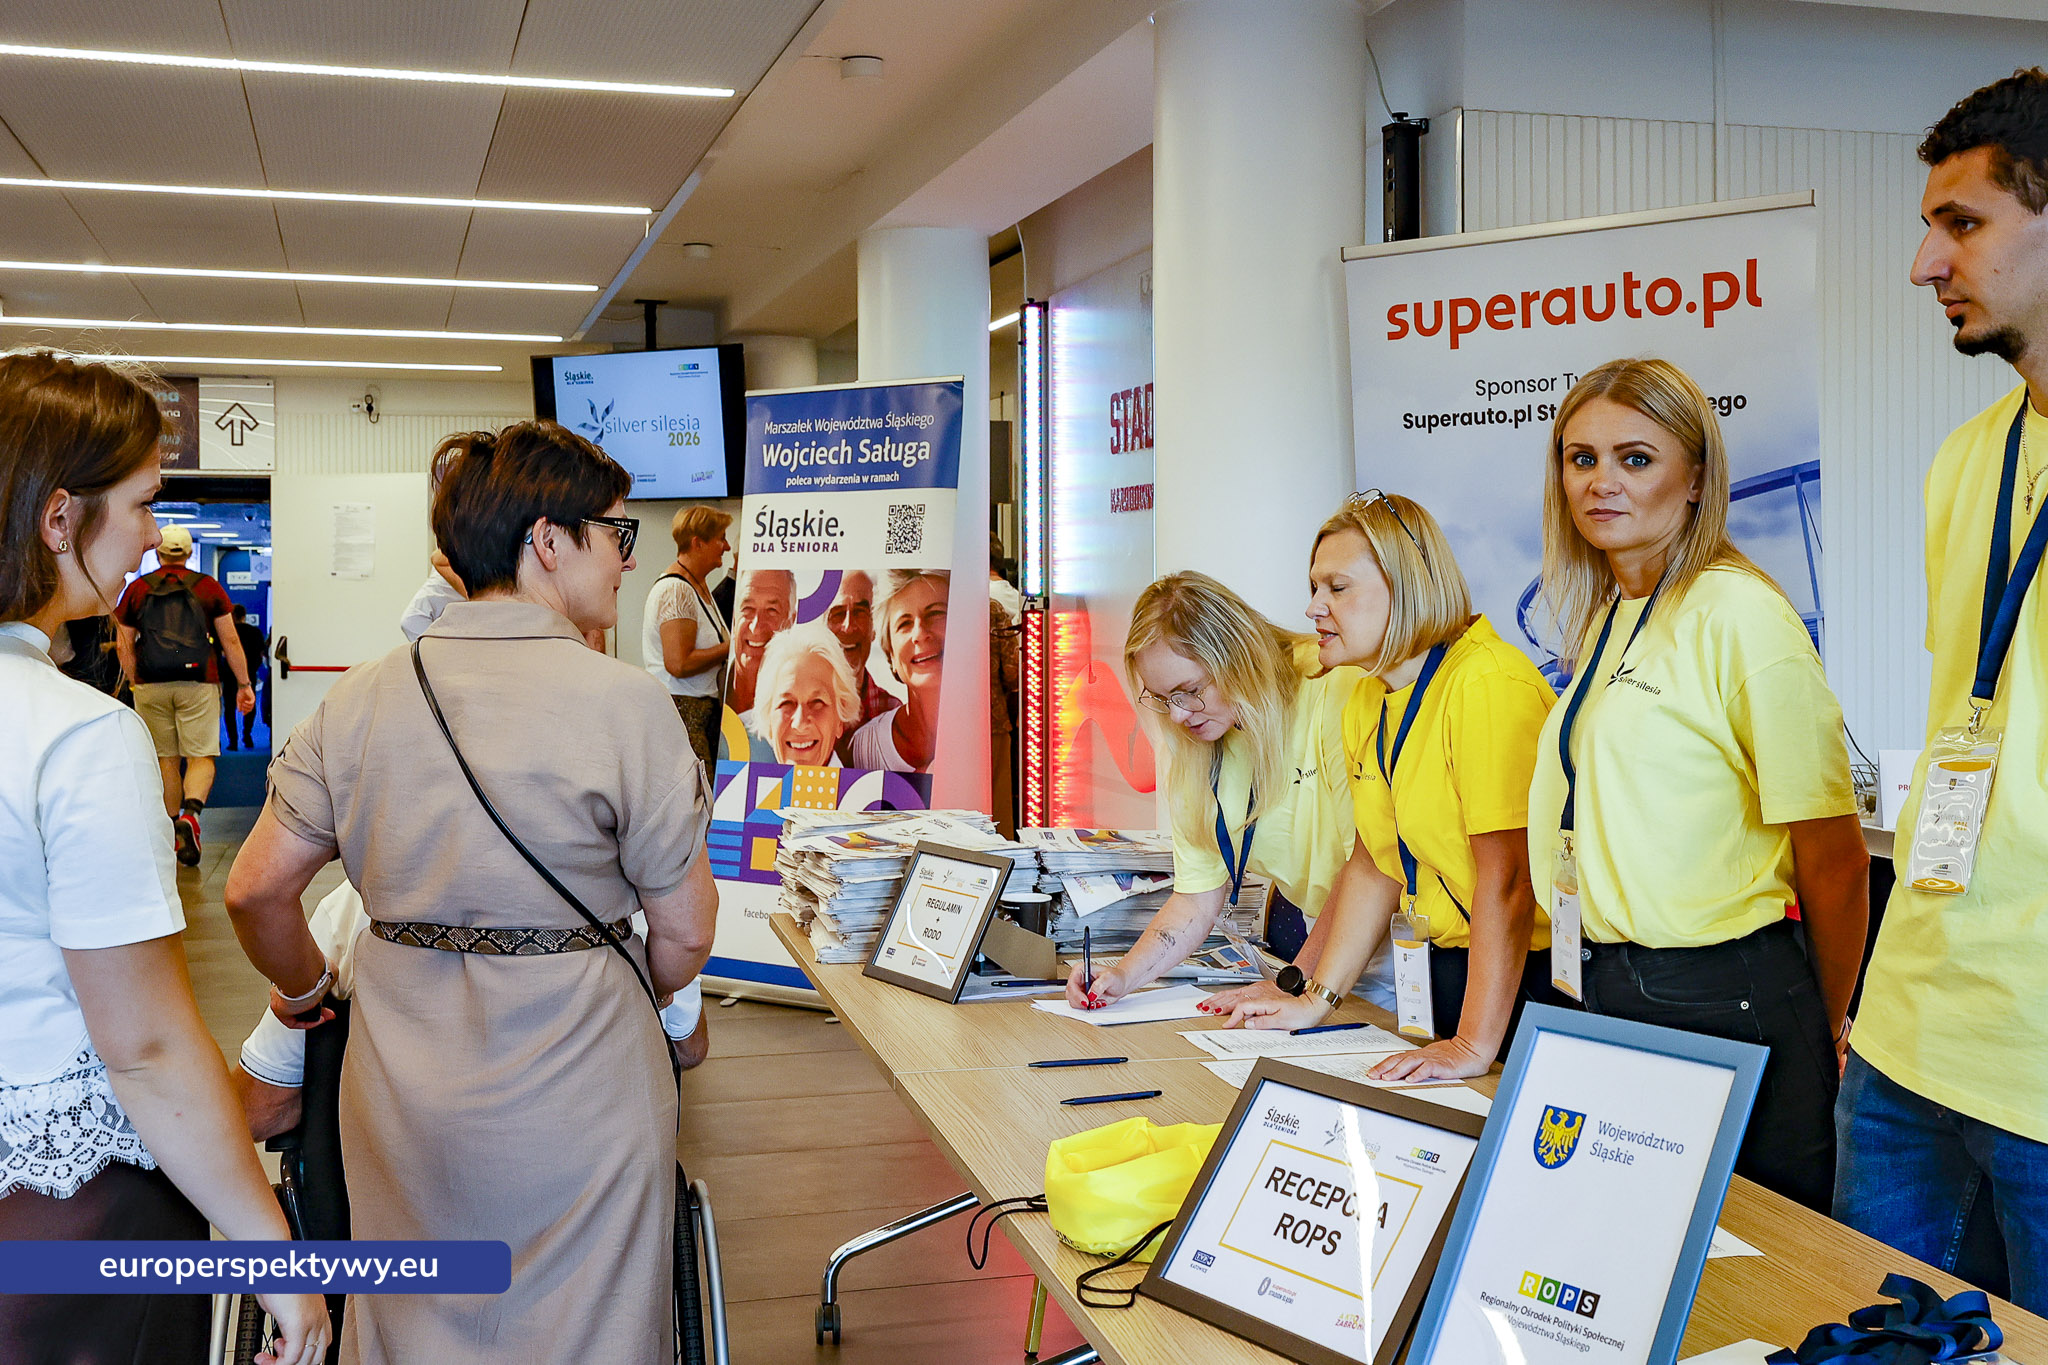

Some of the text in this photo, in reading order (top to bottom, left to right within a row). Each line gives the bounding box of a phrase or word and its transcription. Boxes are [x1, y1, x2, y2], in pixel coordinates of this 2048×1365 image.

[1387, 258, 1762, 350] superauto.pl
[1475, 376, 1557, 400] Sponsor
[605, 414, 700, 434] silver silesia
[764, 411, 935, 435] Marszałek Województwa Śląskiego
[1403, 404, 1532, 433] Superauto.pl
[668, 431, 700, 447] 2026
[762, 436, 931, 473] Wojciech Saługa
[786, 471, 900, 488] poleca wydarzenia w ramach
[753, 504, 845, 545] Śląskie.
[752, 541, 839, 553] DLA SENIORA
[925, 897, 963, 915] REGULAMIN
[922, 927, 942, 941] RODO
[1598, 1120, 1685, 1155] Województwo
[1589, 1139, 1635, 1166] Śląskie
[1264, 1166, 1389, 1229] RECEPCA
[1273, 1212, 1342, 1256] ROPS
[1521, 1274, 1598, 1316] ROPS
[1479, 1291, 1626, 1352] Regionalny Ośrodek Polityki Społecznej
[1554, 1331, 1591, 1353] Śląskiego
